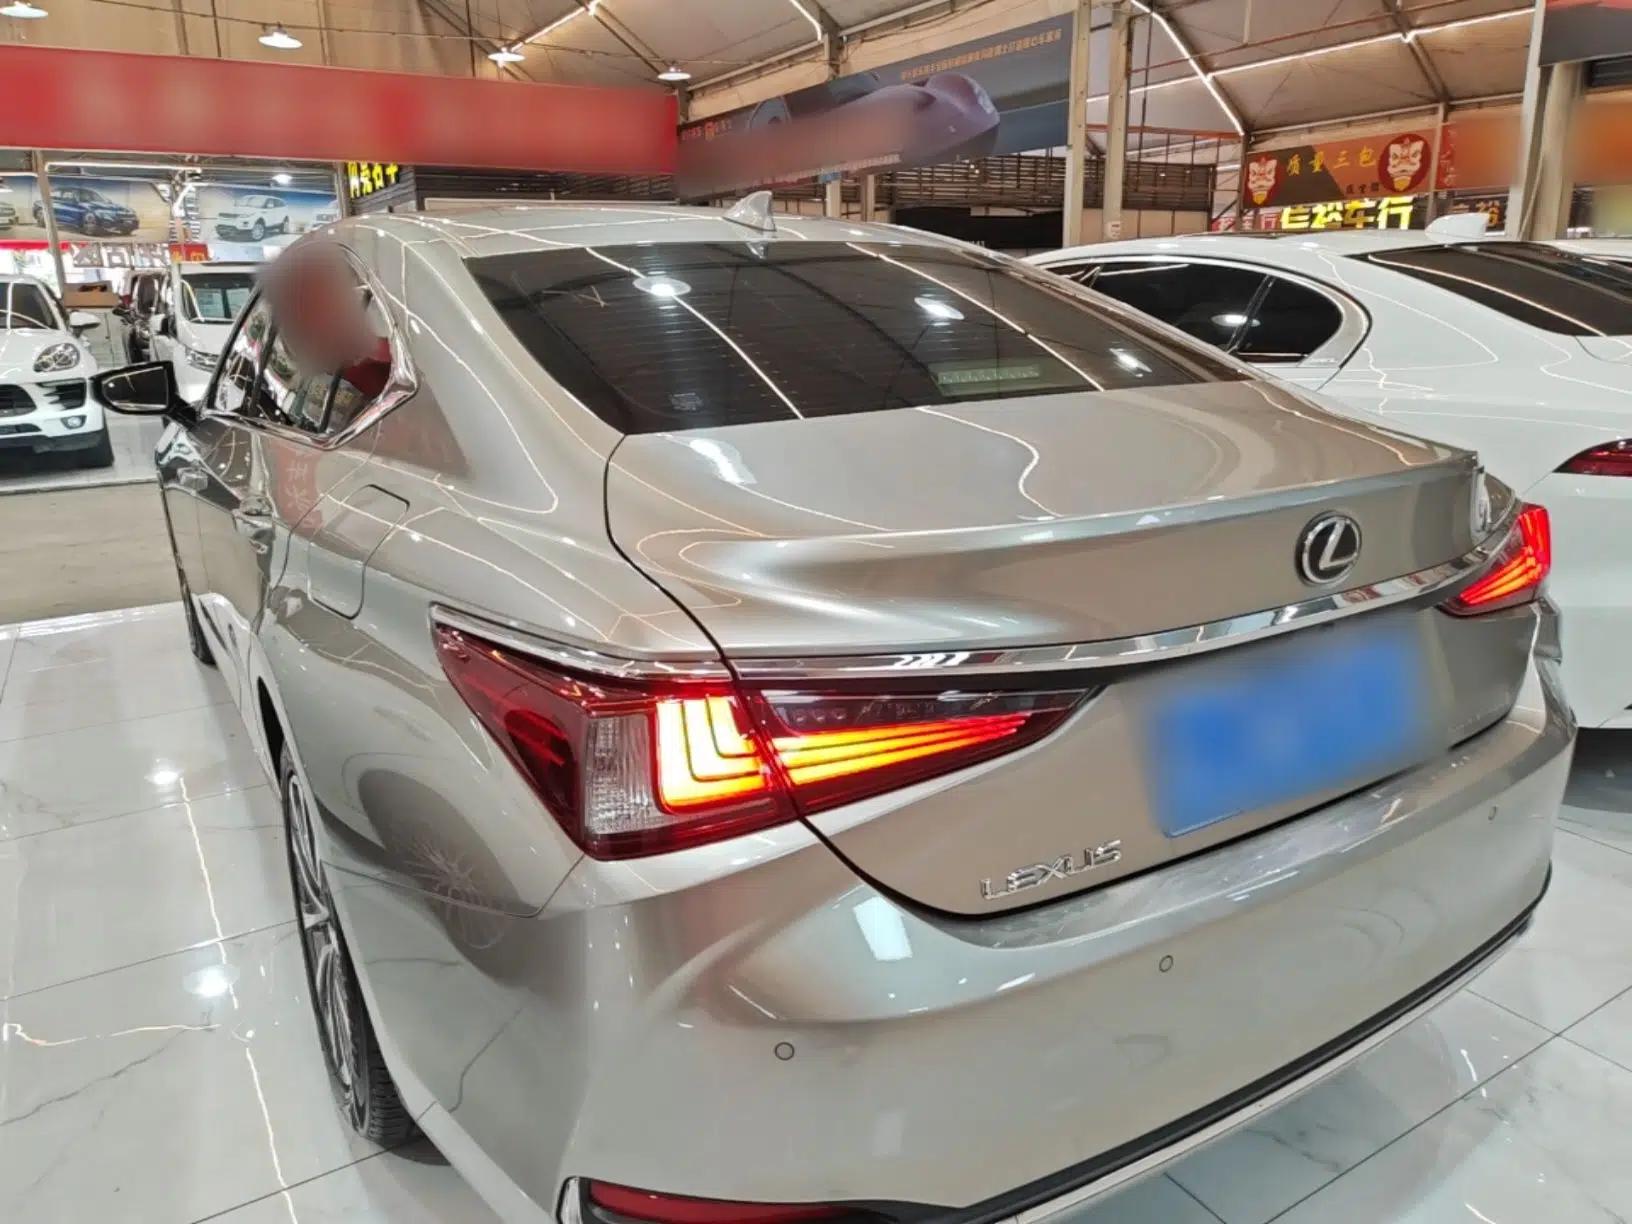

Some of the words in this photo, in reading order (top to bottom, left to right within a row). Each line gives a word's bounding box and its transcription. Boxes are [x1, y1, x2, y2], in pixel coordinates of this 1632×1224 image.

[1286, 145, 1376, 177] 质量三包
[980, 839, 1122, 900] LEXUS
